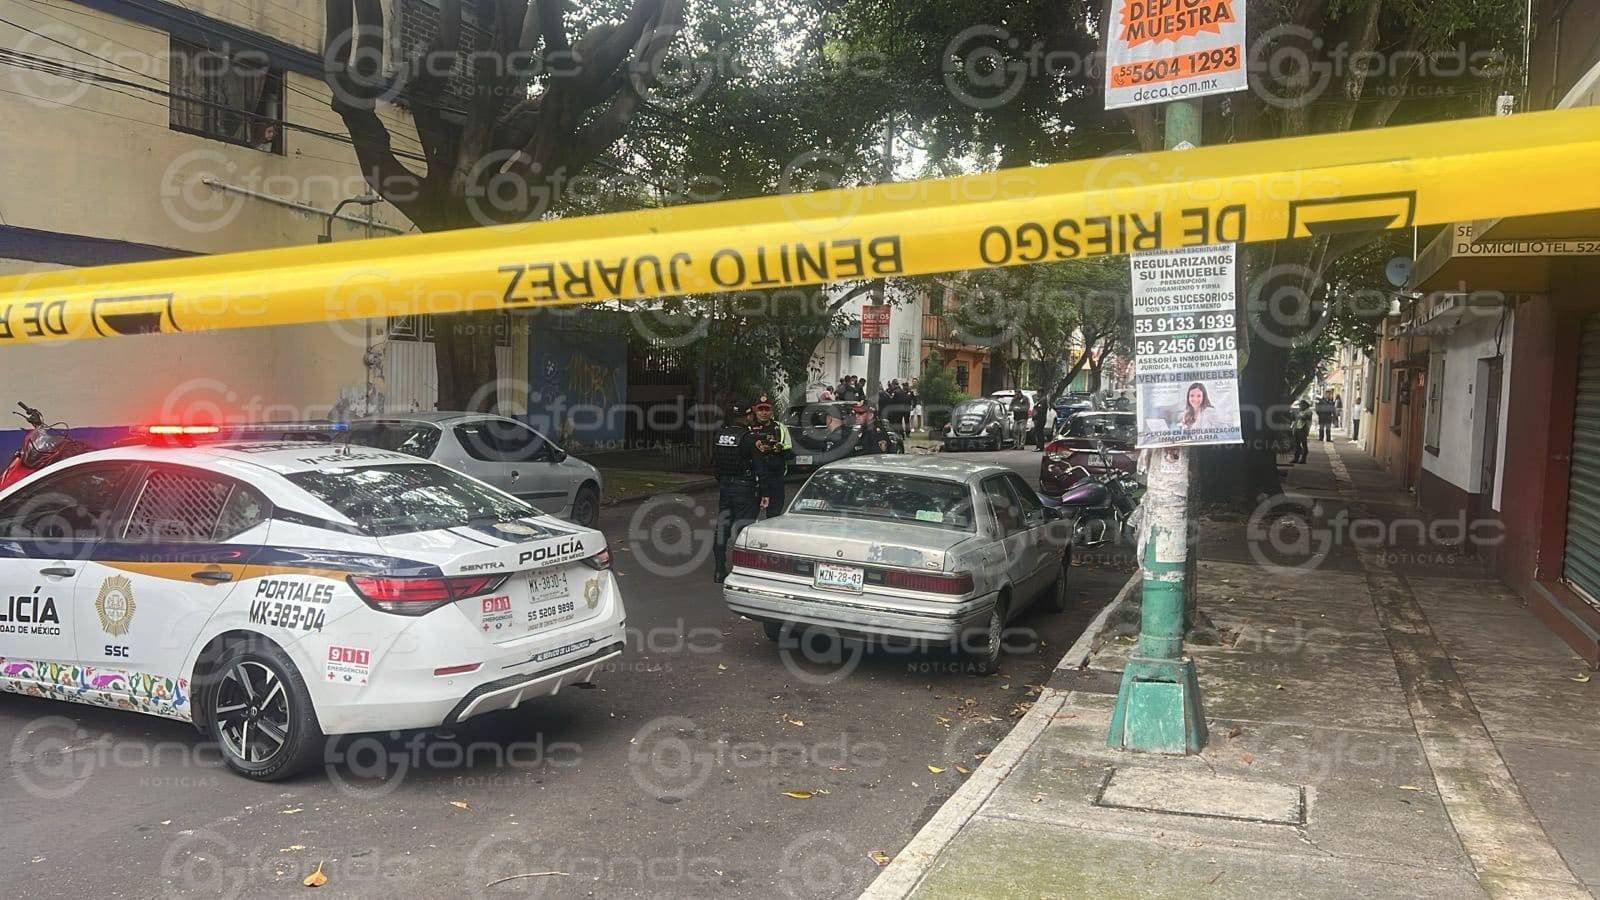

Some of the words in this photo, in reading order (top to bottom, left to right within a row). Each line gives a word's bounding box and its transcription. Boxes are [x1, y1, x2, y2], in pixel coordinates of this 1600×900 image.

[1127, 2, 1230, 41] MUESTRA
[1132, 58, 1180, 83] 5604
[1188, 47, 1237, 72] 1293
[1134, 78, 1218, 101] deca.com.mx
[1182, 204, 1247, 247] DE
[979, 211, 1162, 265] RIESGO
[1457, 242, 1544, 254] DOMICILIO
[709, 235, 902, 288] BENITO
[1134, 255, 1232, 270] REGULARIZAMOS
[498, 251, 692, 304] JUAREZ
[1140, 271, 1156, 280] SU
[1160, 267, 1227, 279] INMUEBLE
[1135, 295, 1170, 306] JUICIOS
[1173, 292, 1234, 304] SUCESORIOS
[1135, 318, 1153, 332] 55
[1157, 316, 1195, 331] 9133
[1200, 314, 1234, 329] 1939
[1137, 340, 1155, 355] 56
[1158, 338, 1195, 353] 2456
[1200, 336, 1236, 351] 0916
[1138, 374, 1167, 383] VENTA
[1170, 372, 1181, 381] DE
[1183, 370, 1235, 381] INMUEBLES
[719, 434, 736, 445] SSC
[518, 537, 584, 565] POLICÍA
[460, 561, 505, 572] SENTRA
[255, 579, 335, 604] PORTALES
[483, 597, 511, 612] 911
[18, 626, 28, 634] DE
[31, 624, 60, 635] MÉXICO
[105, 645, 129, 657] SSC
[329, 646, 369, 665] 911
